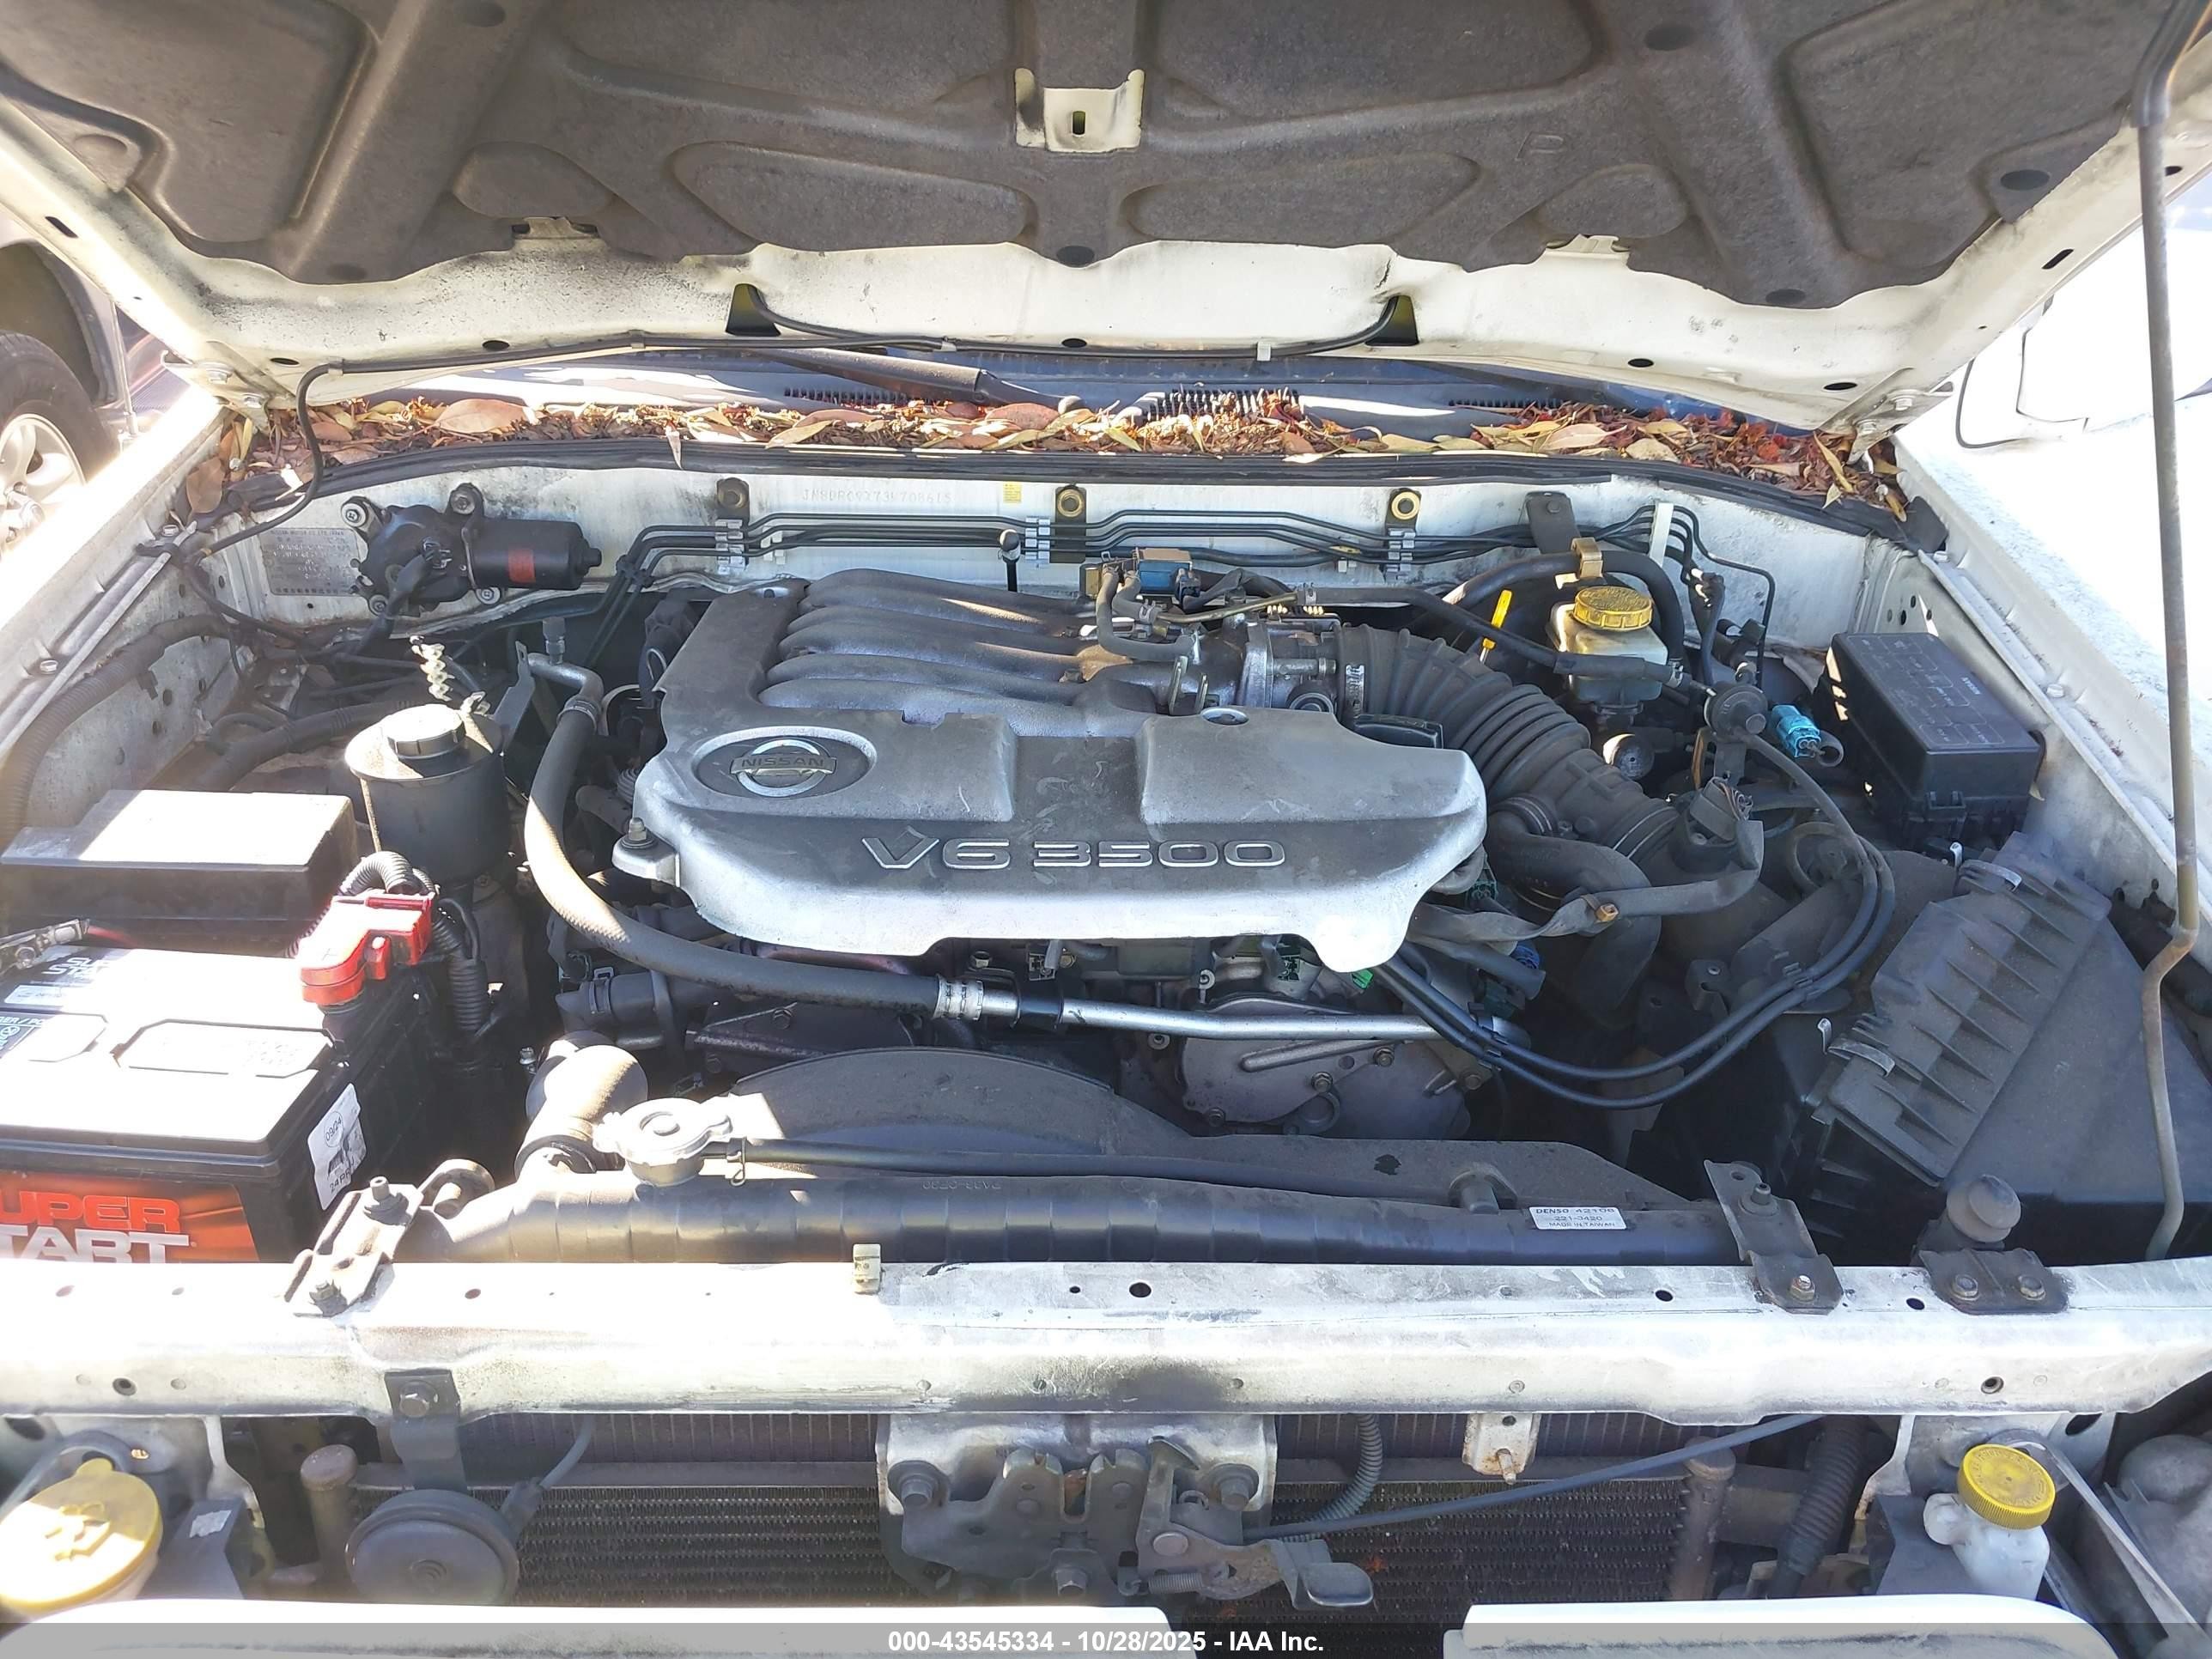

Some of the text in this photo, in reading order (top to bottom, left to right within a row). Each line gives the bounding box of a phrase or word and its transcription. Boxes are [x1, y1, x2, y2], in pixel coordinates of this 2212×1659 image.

[741, 757, 824, 769] NISSAN
[861, 836, 1286, 871] V6 3500
[325, 1117, 343, 1141] 09/24
